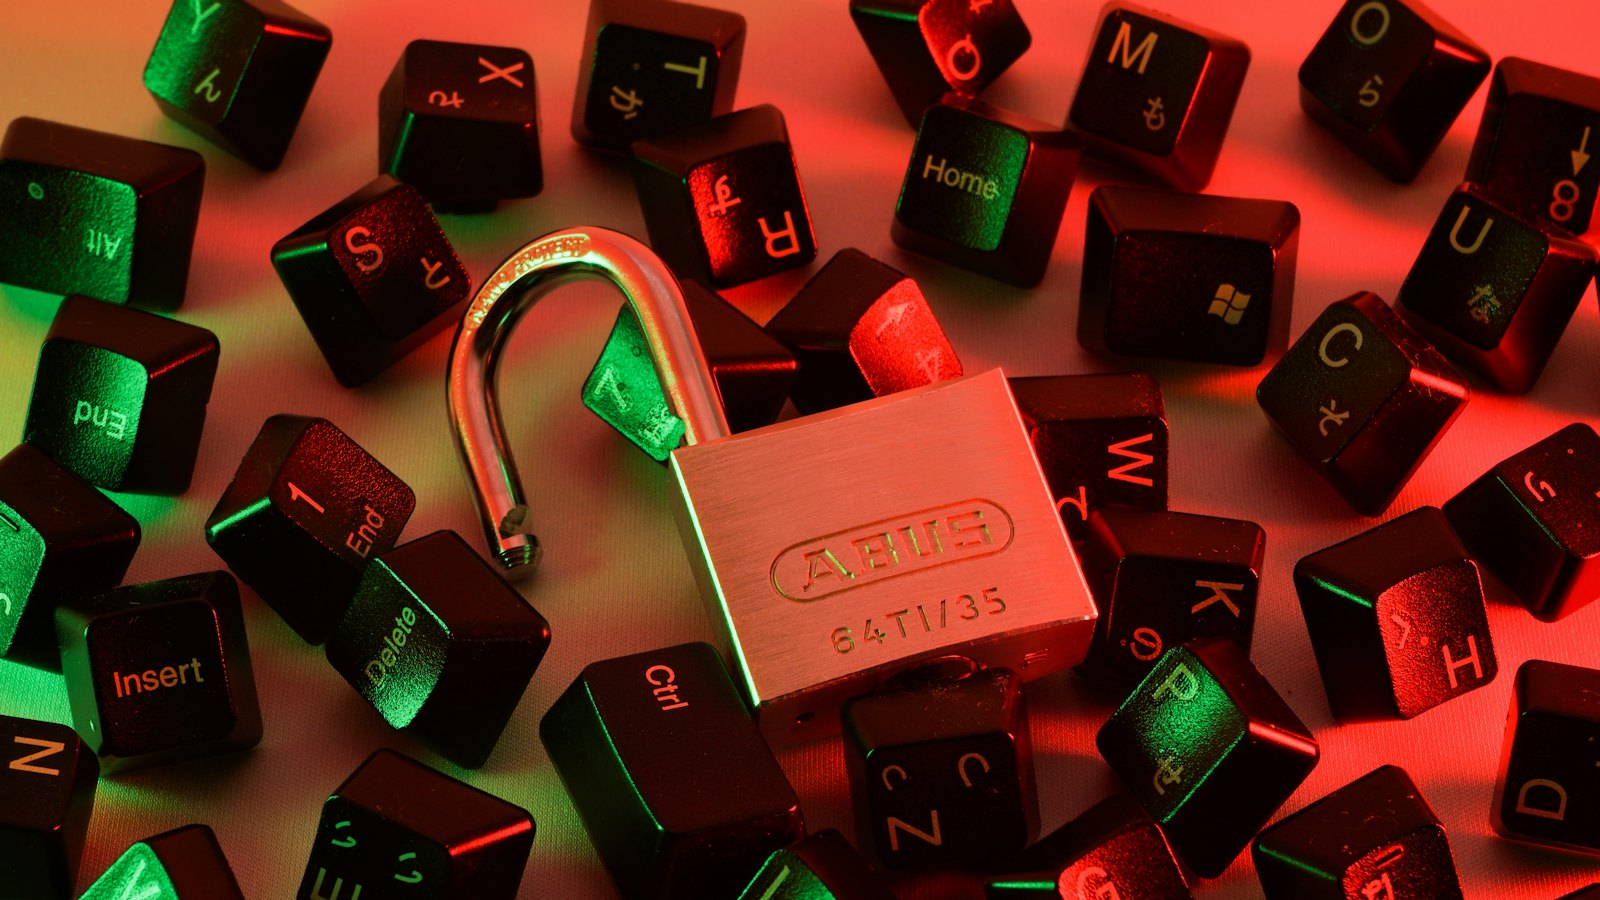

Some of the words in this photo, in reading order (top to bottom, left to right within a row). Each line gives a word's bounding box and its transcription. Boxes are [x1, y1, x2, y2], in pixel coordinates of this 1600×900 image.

[1350, 0, 1391, 46] O
[947, 33, 981, 81] Q
[1107, 21, 1159, 75] M
[194, 68, 221, 103] ん
[478, 56, 525, 88] X
[664, 56, 707, 89] T
[1358, 74, 1384, 107] ら
[609, 84, 643, 121] か
[1142, 96, 1166, 131] も
[711, 174, 742, 218] す
[921, 153, 1000, 201] Home
[1550, 179, 1581, 222] 8
[86, 229, 123, 260] Alt
[345, 226, 384, 272] S
[757, 210, 801, 259] R
[1449, 205, 1494, 255] U
[420, 257, 451, 290] と
[1318, 322, 1364, 368] C
[74, 400, 128, 440] End
[1318, 399, 1350, 437] そ
[1107, 433, 1154, 487] W
[287, 481, 325, 514] 1
[1524, 471, 1557, 502] り
[345, 504, 385, 559] End
[801, 509, 993, 593] ABUS
[1192, 580, 1244, 618] K
[830, 586, 1007, 655] 64TI/35
[364, 604, 418, 688] Delete
[1129, 627, 1163, 661] の
[1442, 635, 1484, 690] H
[113, 657, 205, 698] Insert
[645, 664, 689, 712] Ctrl
[1153, 662, 1200, 702] P
[8, 735, 66, 777] N
[1153, 756, 1184, 796] せ
[1515, 778, 1568, 821] D
[886, 809, 943, 851] Z
[394, 852, 423, 884] い
